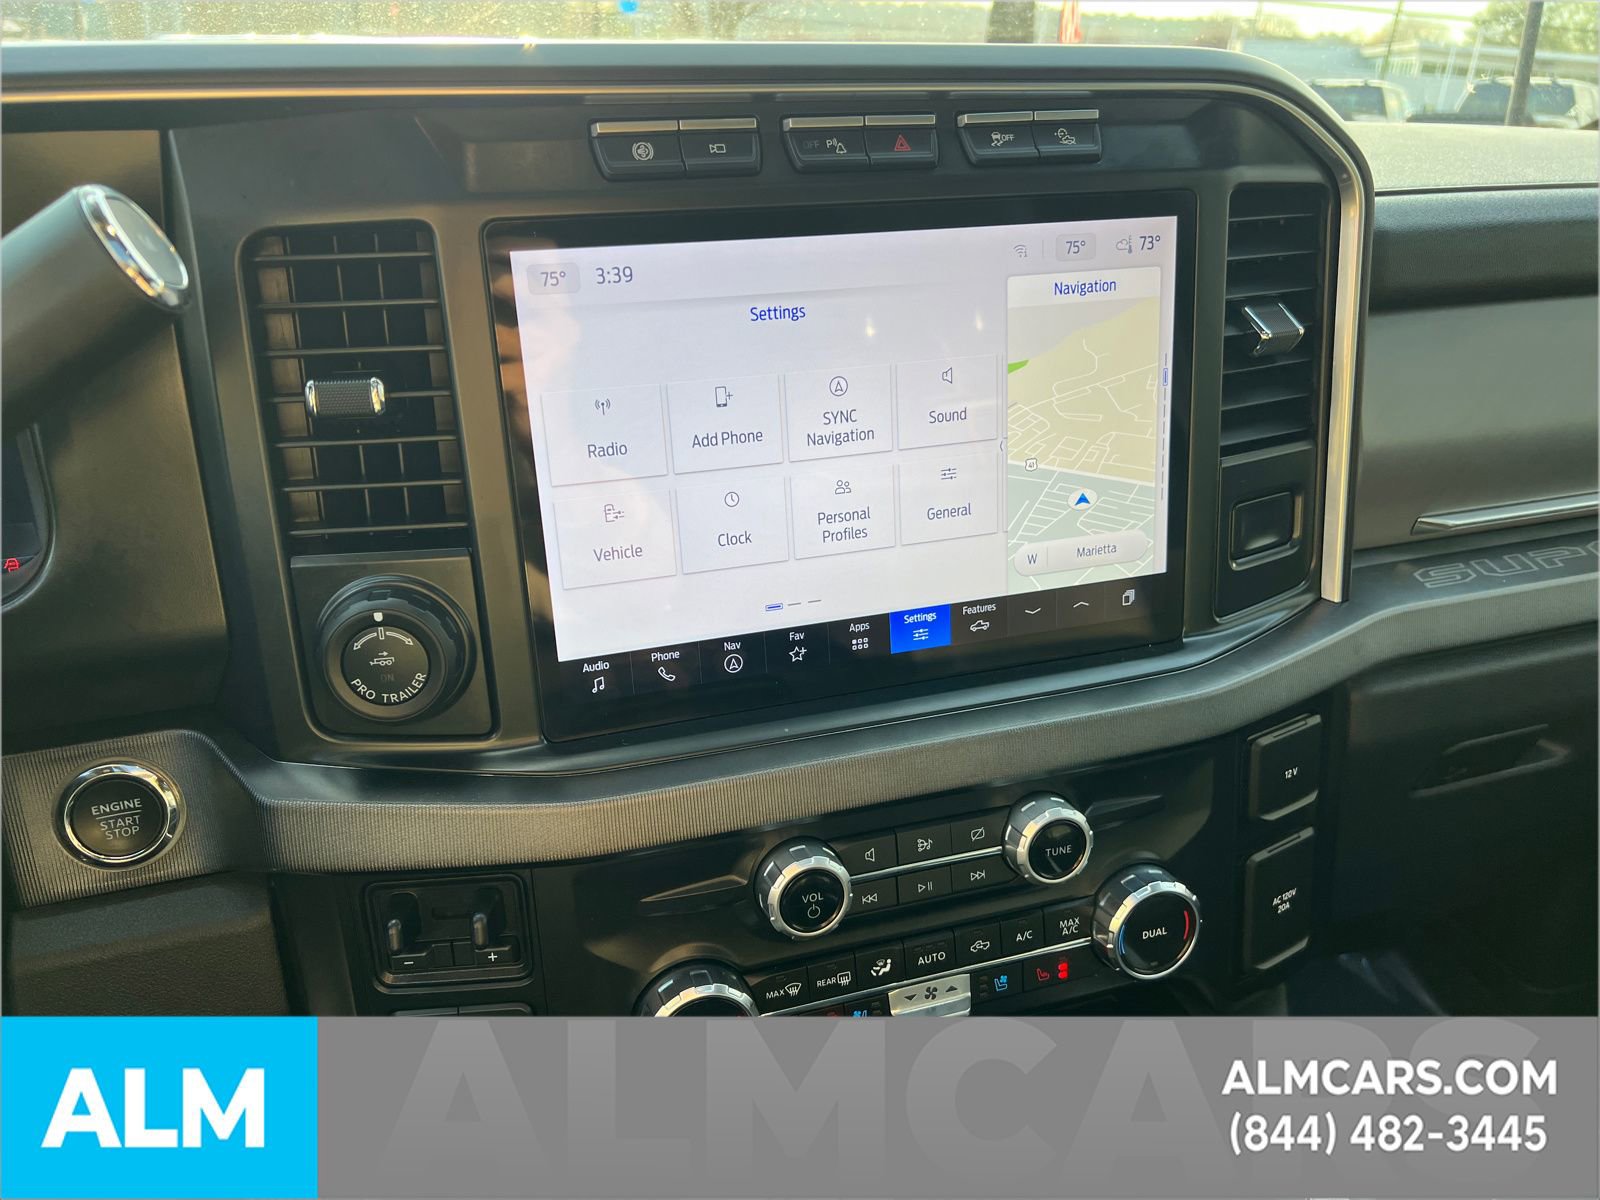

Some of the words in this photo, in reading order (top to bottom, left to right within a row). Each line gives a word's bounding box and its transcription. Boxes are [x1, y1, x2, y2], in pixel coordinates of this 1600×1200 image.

[1001, 134, 1015, 142] OFF
[1065, 240, 1086, 255] 75°
[1139, 234, 1161, 251] 73°
[541, 271, 567, 287] 75°
[595, 266, 634, 285] 3:39
[1054, 279, 1117, 296] Navigation
[749, 304, 806, 322] Settings
[822, 409, 857, 426] SYNC
[928, 407, 968, 425] Sound
[692, 433, 719, 449] Add
[721, 429, 764, 446] Phone
[806, 427, 875, 447] Navigation
[587, 441, 628, 459] Radio
[1026, 460, 1036, 470] 41
[817, 506, 871, 525] Personal
[926, 502, 972, 521] General
[717, 530, 752, 547] Clock
[822, 525, 868, 543] Profiles
[592, 544, 643, 562] Vehicle
[1076, 542, 1117, 559] Marietta
[1027, 553, 1038, 566] W
[1413, 540, 1600, 589] SUP
[962, 602, 996, 617] Features
[903, 611, 937, 625] Settings
[849, 620, 870, 634] Apps
[788, 631, 805, 642] Fav
[723, 641, 741, 652] Nav
[651, 649, 680, 663] Phone
[582, 659, 610, 674] Audio
[351, 678, 376, 700] PRO
[381, 672, 427, 704] TRAILER
[1285, 769, 1293, 779] 12
[91, 798, 142, 816] ENGINE
[99, 815, 141, 831] START
[105, 827, 140, 840] STOP
[1045, 844, 1073, 857] TUNE
[801, 892, 825, 904] VOL
[1273, 895, 1281, 906] AC
[1282, 888, 1297, 901] 120V
[1278, 902, 1290, 914] 20A
[1059, 917, 1081, 930] MAX
[1062, 925, 1079, 936] A/C
[1016, 930, 1033, 942] A/C
[1142, 926, 1168, 939] DUAL
[917, 951, 947, 967] AUTO
[816, 976, 837, 988] REAR
[765, 987, 785, 1000] MAX
